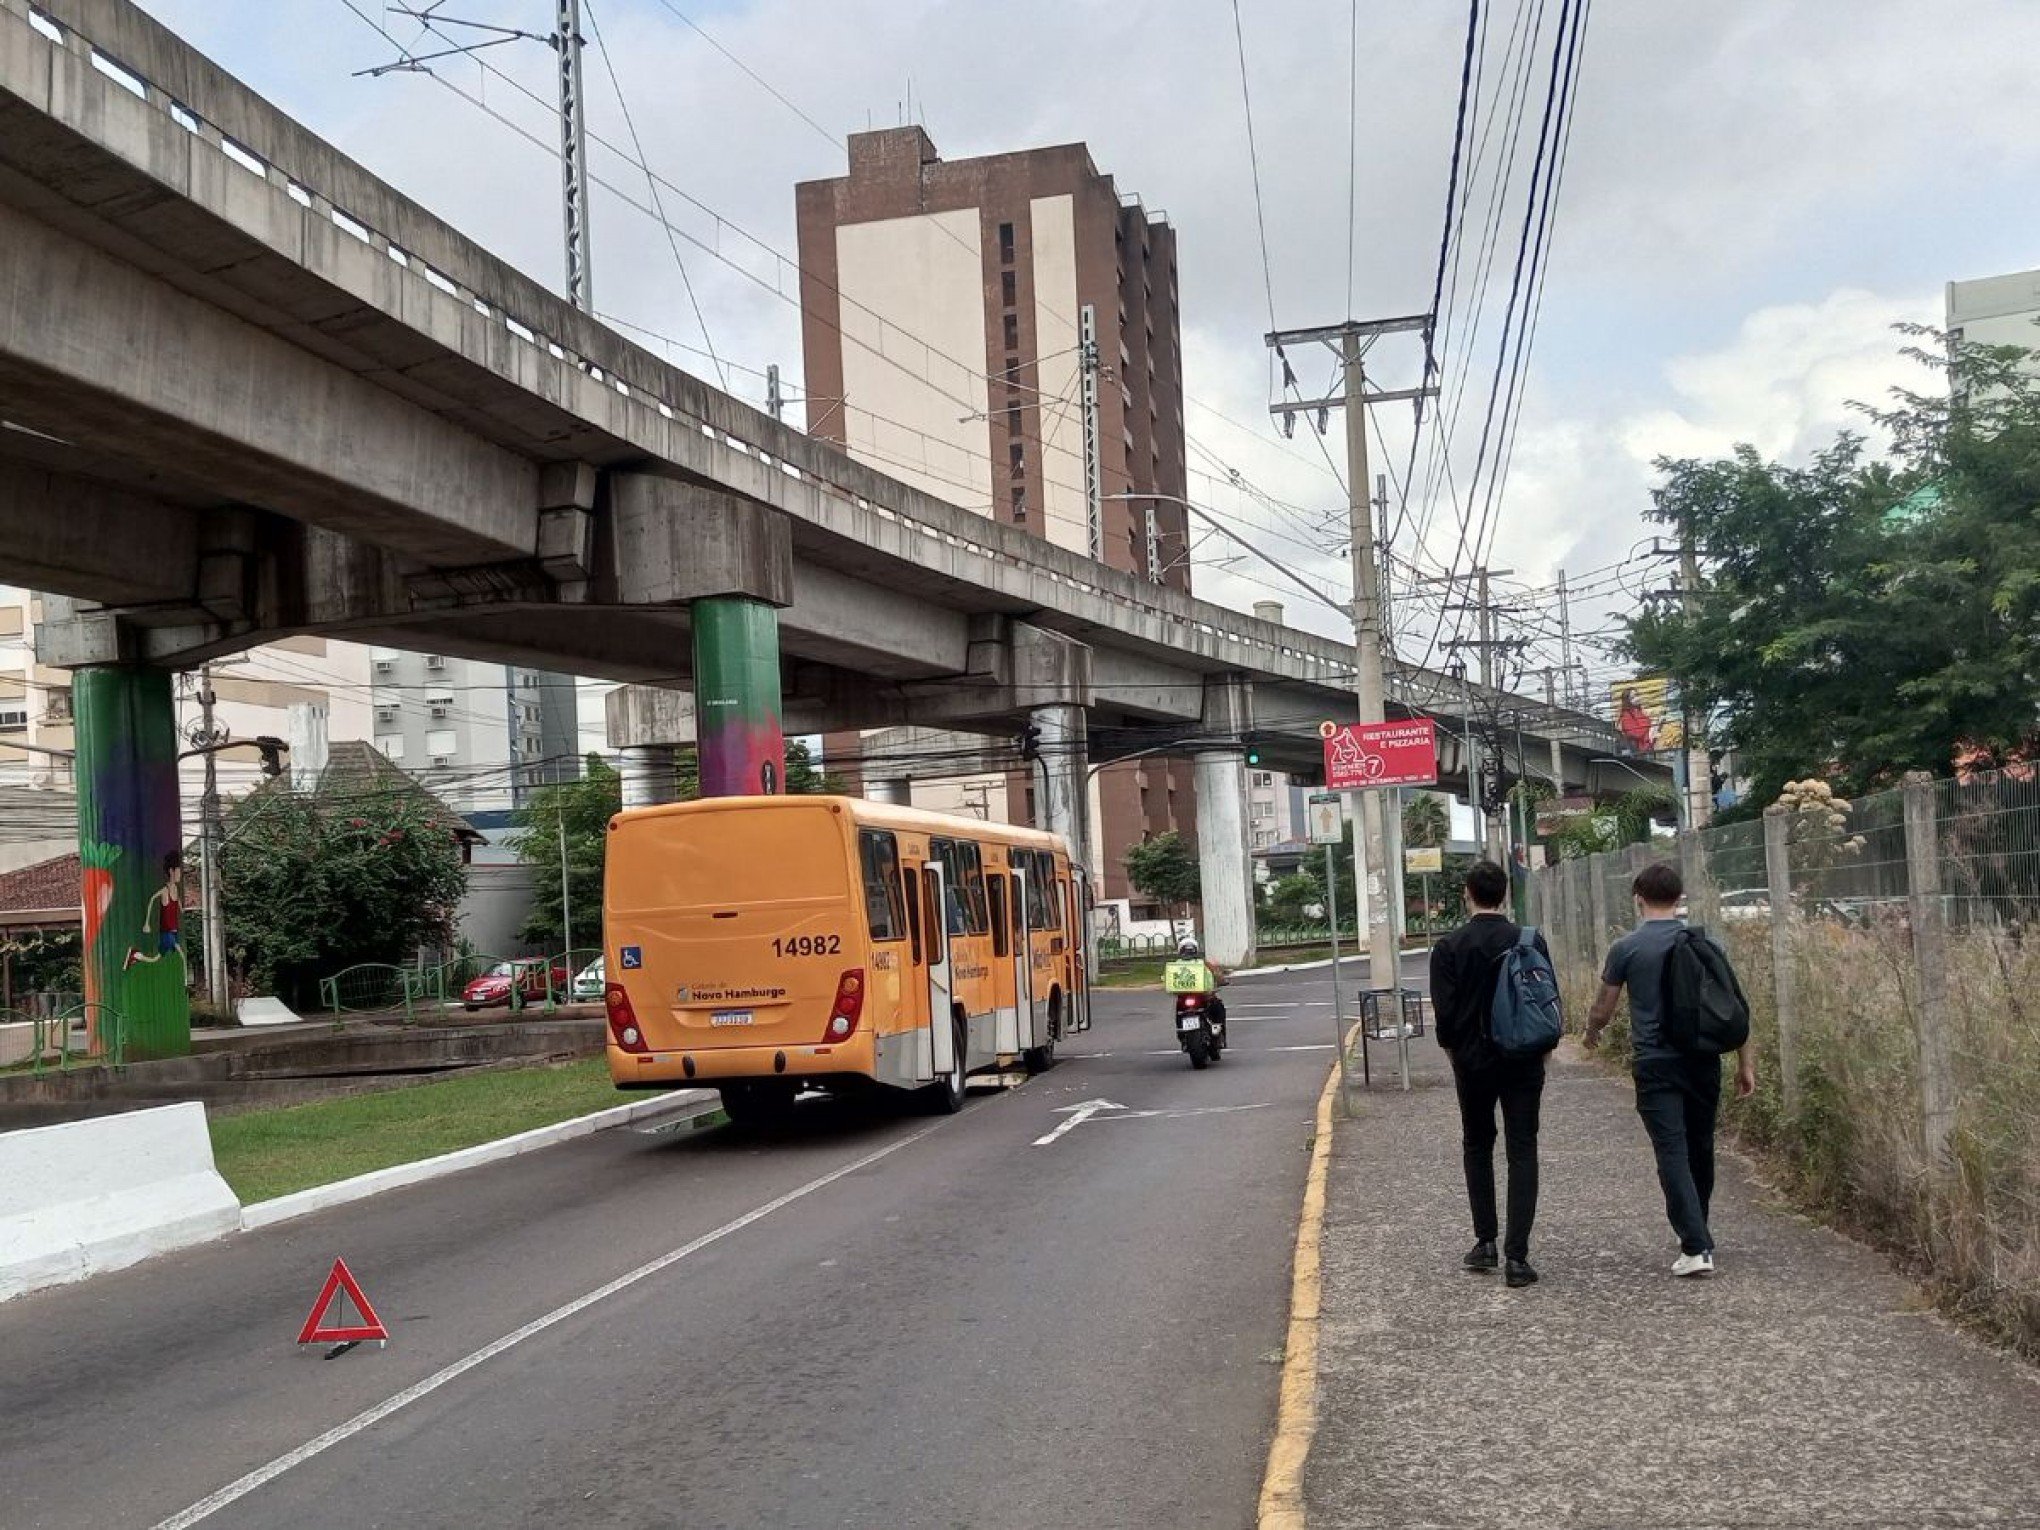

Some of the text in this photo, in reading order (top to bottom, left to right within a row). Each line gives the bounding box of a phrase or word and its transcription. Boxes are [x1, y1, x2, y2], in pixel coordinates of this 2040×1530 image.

[1363, 727, 1429, 740] RESTAURANTE
[1380, 737, 1431, 749] E PIZZARIA
[1368, 759, 1379, 775] 7
[772, 934, 842, 958] 14982
[692, 988, 786, 1001] Novo Hamburgo
